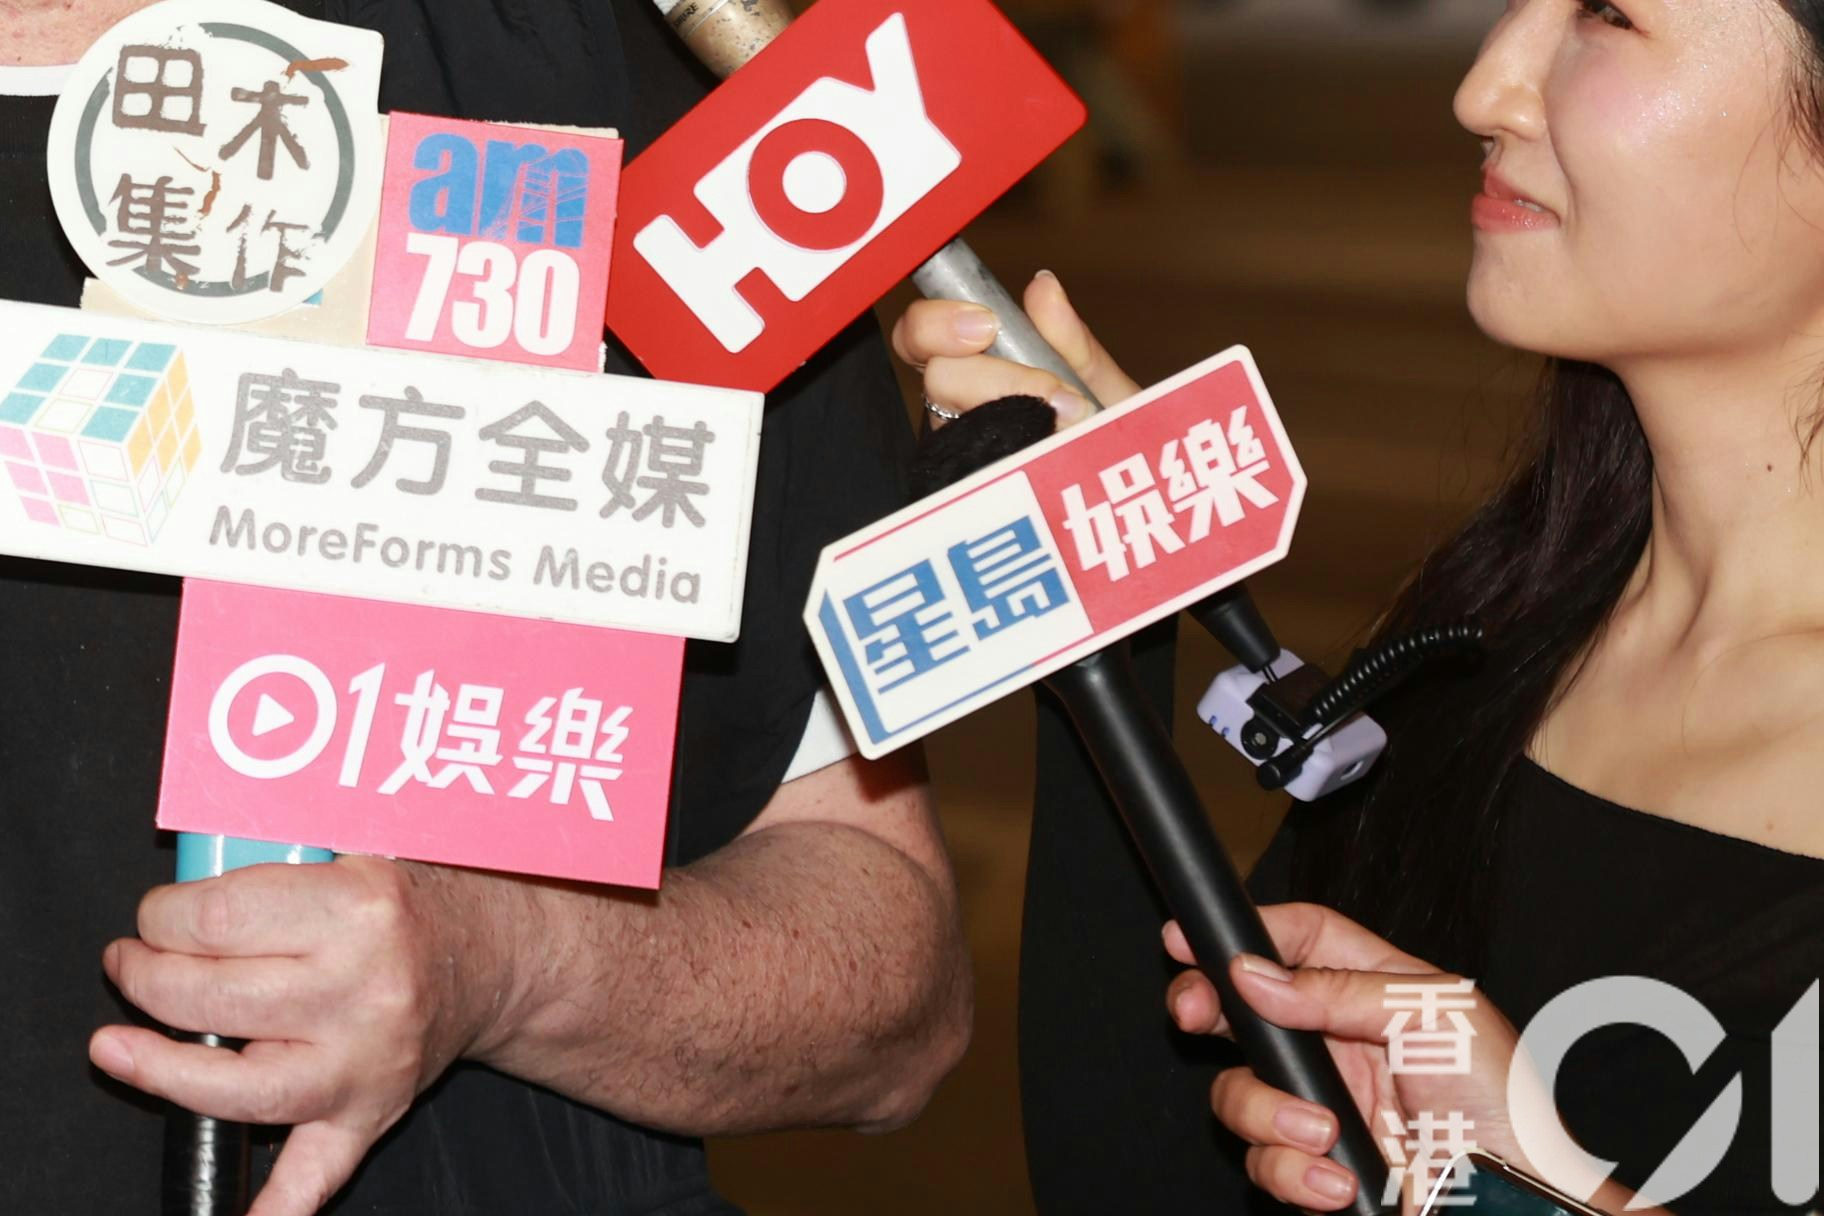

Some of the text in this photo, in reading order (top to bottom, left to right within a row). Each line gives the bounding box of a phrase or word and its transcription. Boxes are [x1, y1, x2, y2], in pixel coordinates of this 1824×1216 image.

[408, 133, 590, 249] am
[633, 12, 962, 353] HOY
[404, 232, 580, 356] 730
[220, 367, 715, 528] 魔方全媒
[209, 504, 702, 604] MoreForms Media
[842, 514, 1070, 695] 星島
